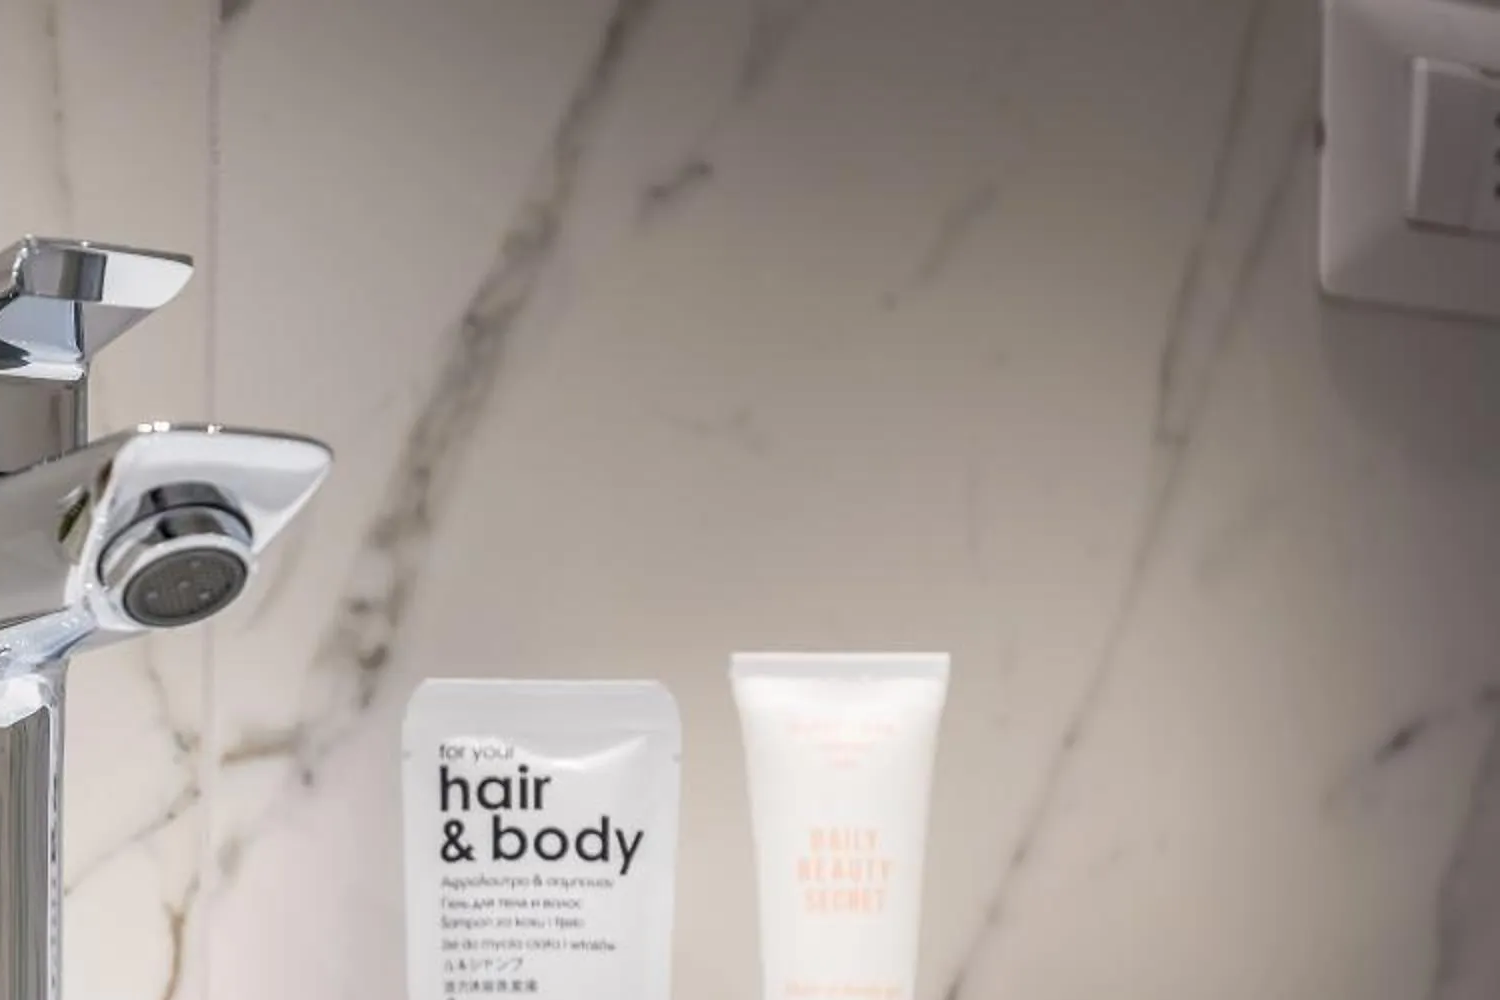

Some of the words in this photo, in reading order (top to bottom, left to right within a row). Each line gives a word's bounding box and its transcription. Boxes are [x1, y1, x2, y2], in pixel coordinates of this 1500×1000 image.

[440, 764, 552, 812] hair
[440, 819, 477, 863] &
[492, 814, 645, 876] body
